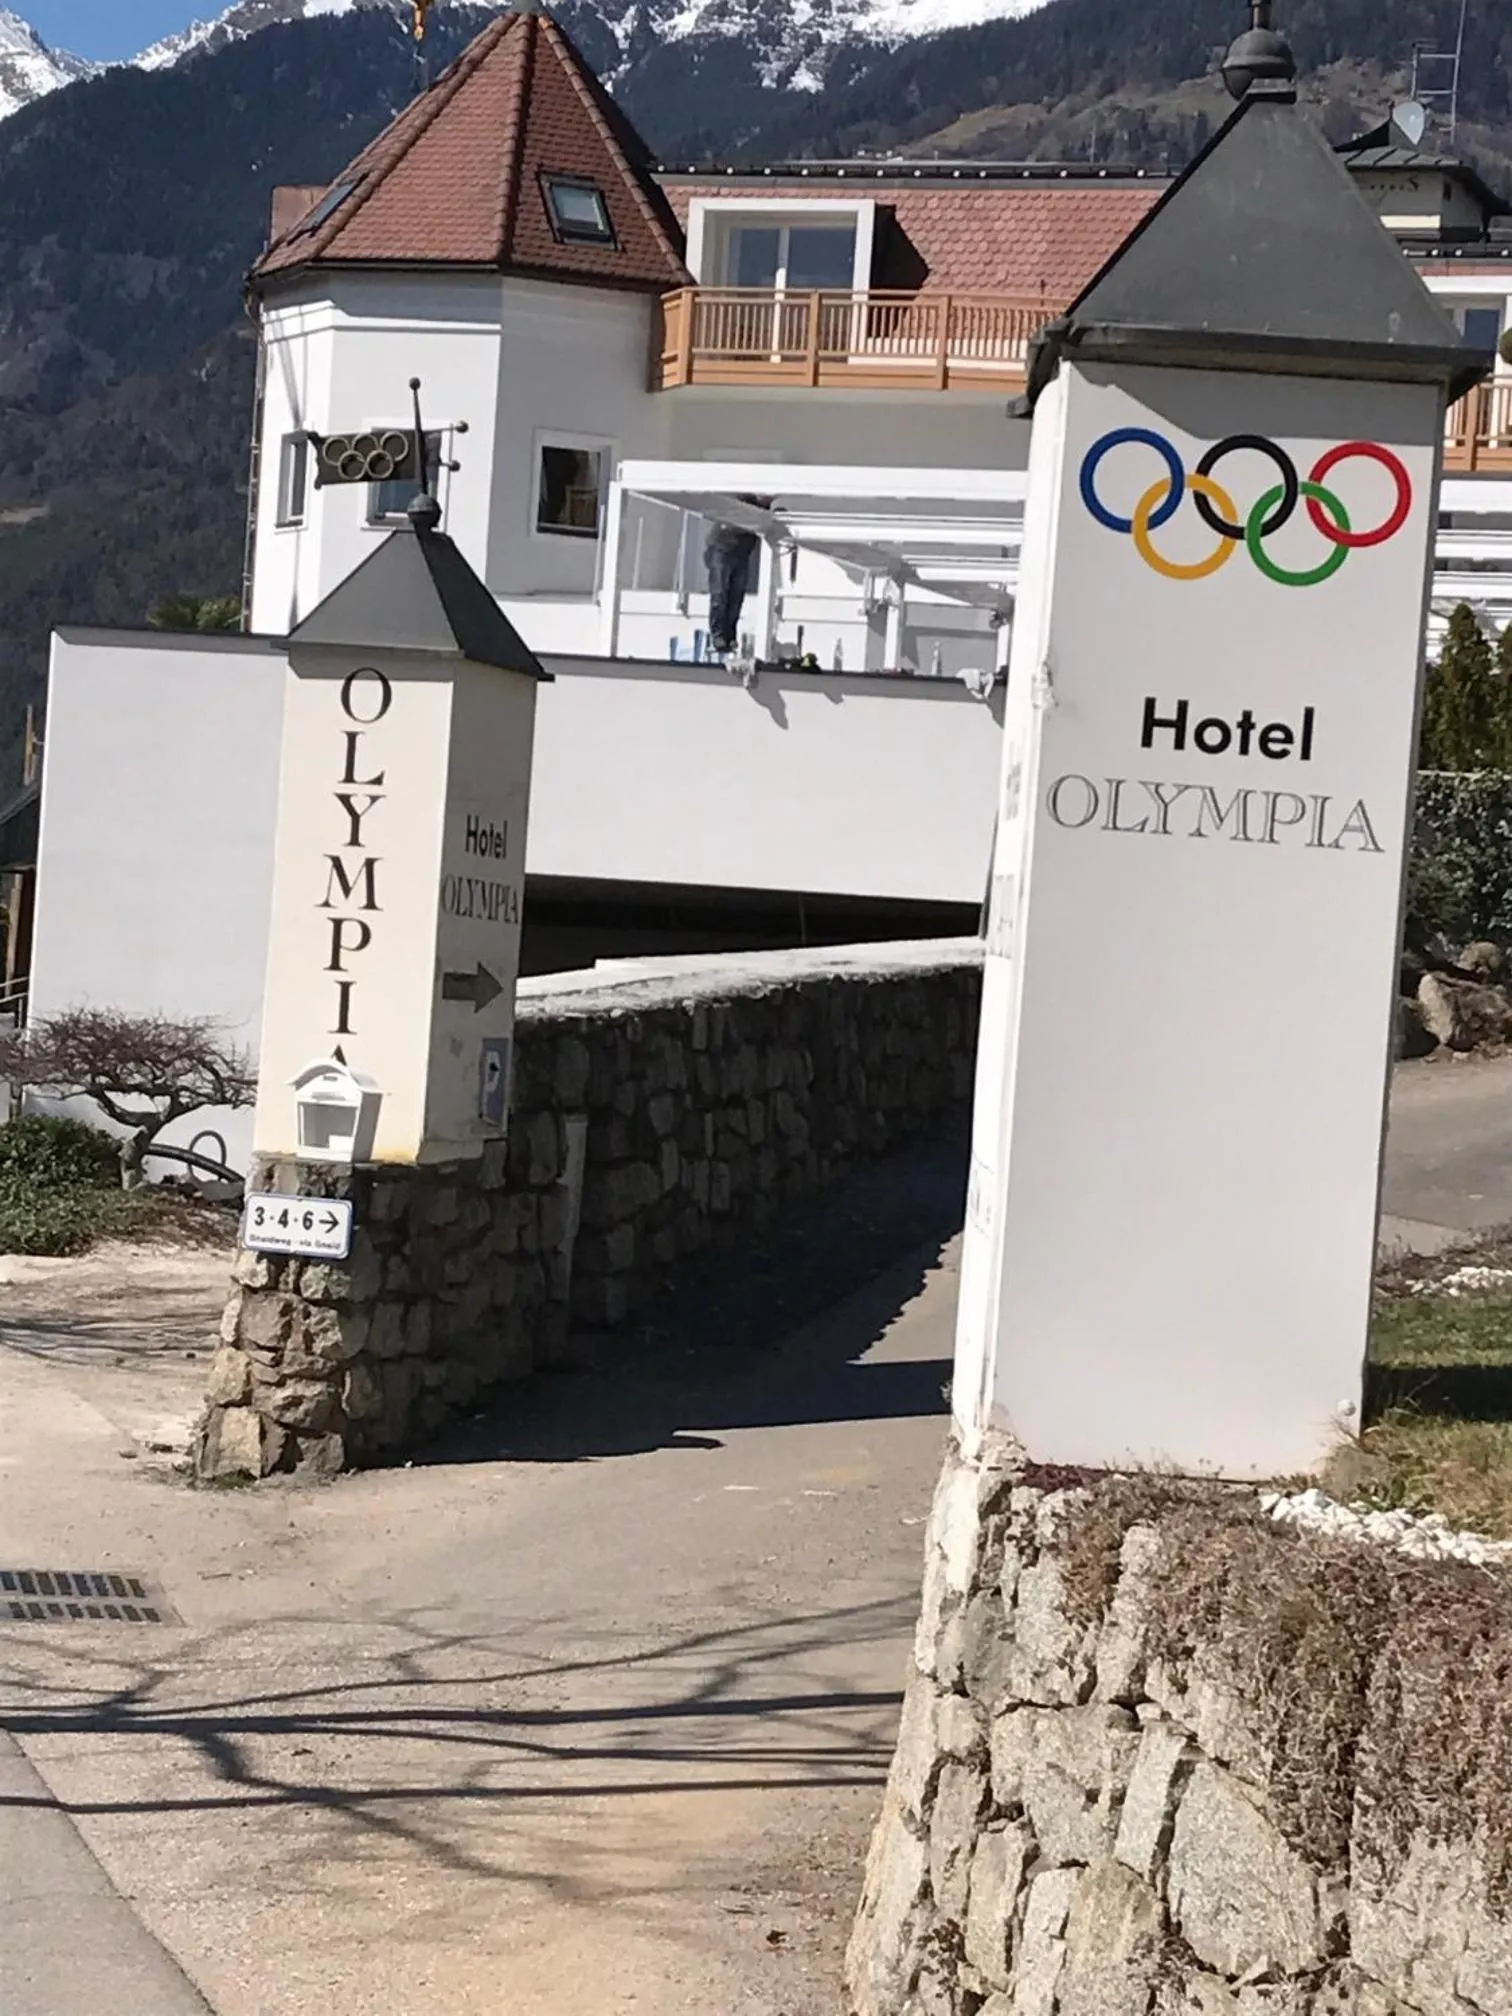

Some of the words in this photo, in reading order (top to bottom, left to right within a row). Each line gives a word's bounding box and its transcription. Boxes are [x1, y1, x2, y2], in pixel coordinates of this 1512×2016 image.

[1140, 696, 1315, 761] Hotel
[465, 813, 508, 860] Hotel
[1046, 773, 1386, 853] OLYMPIA
[441, 873, 519, 925] OLYMPIA
